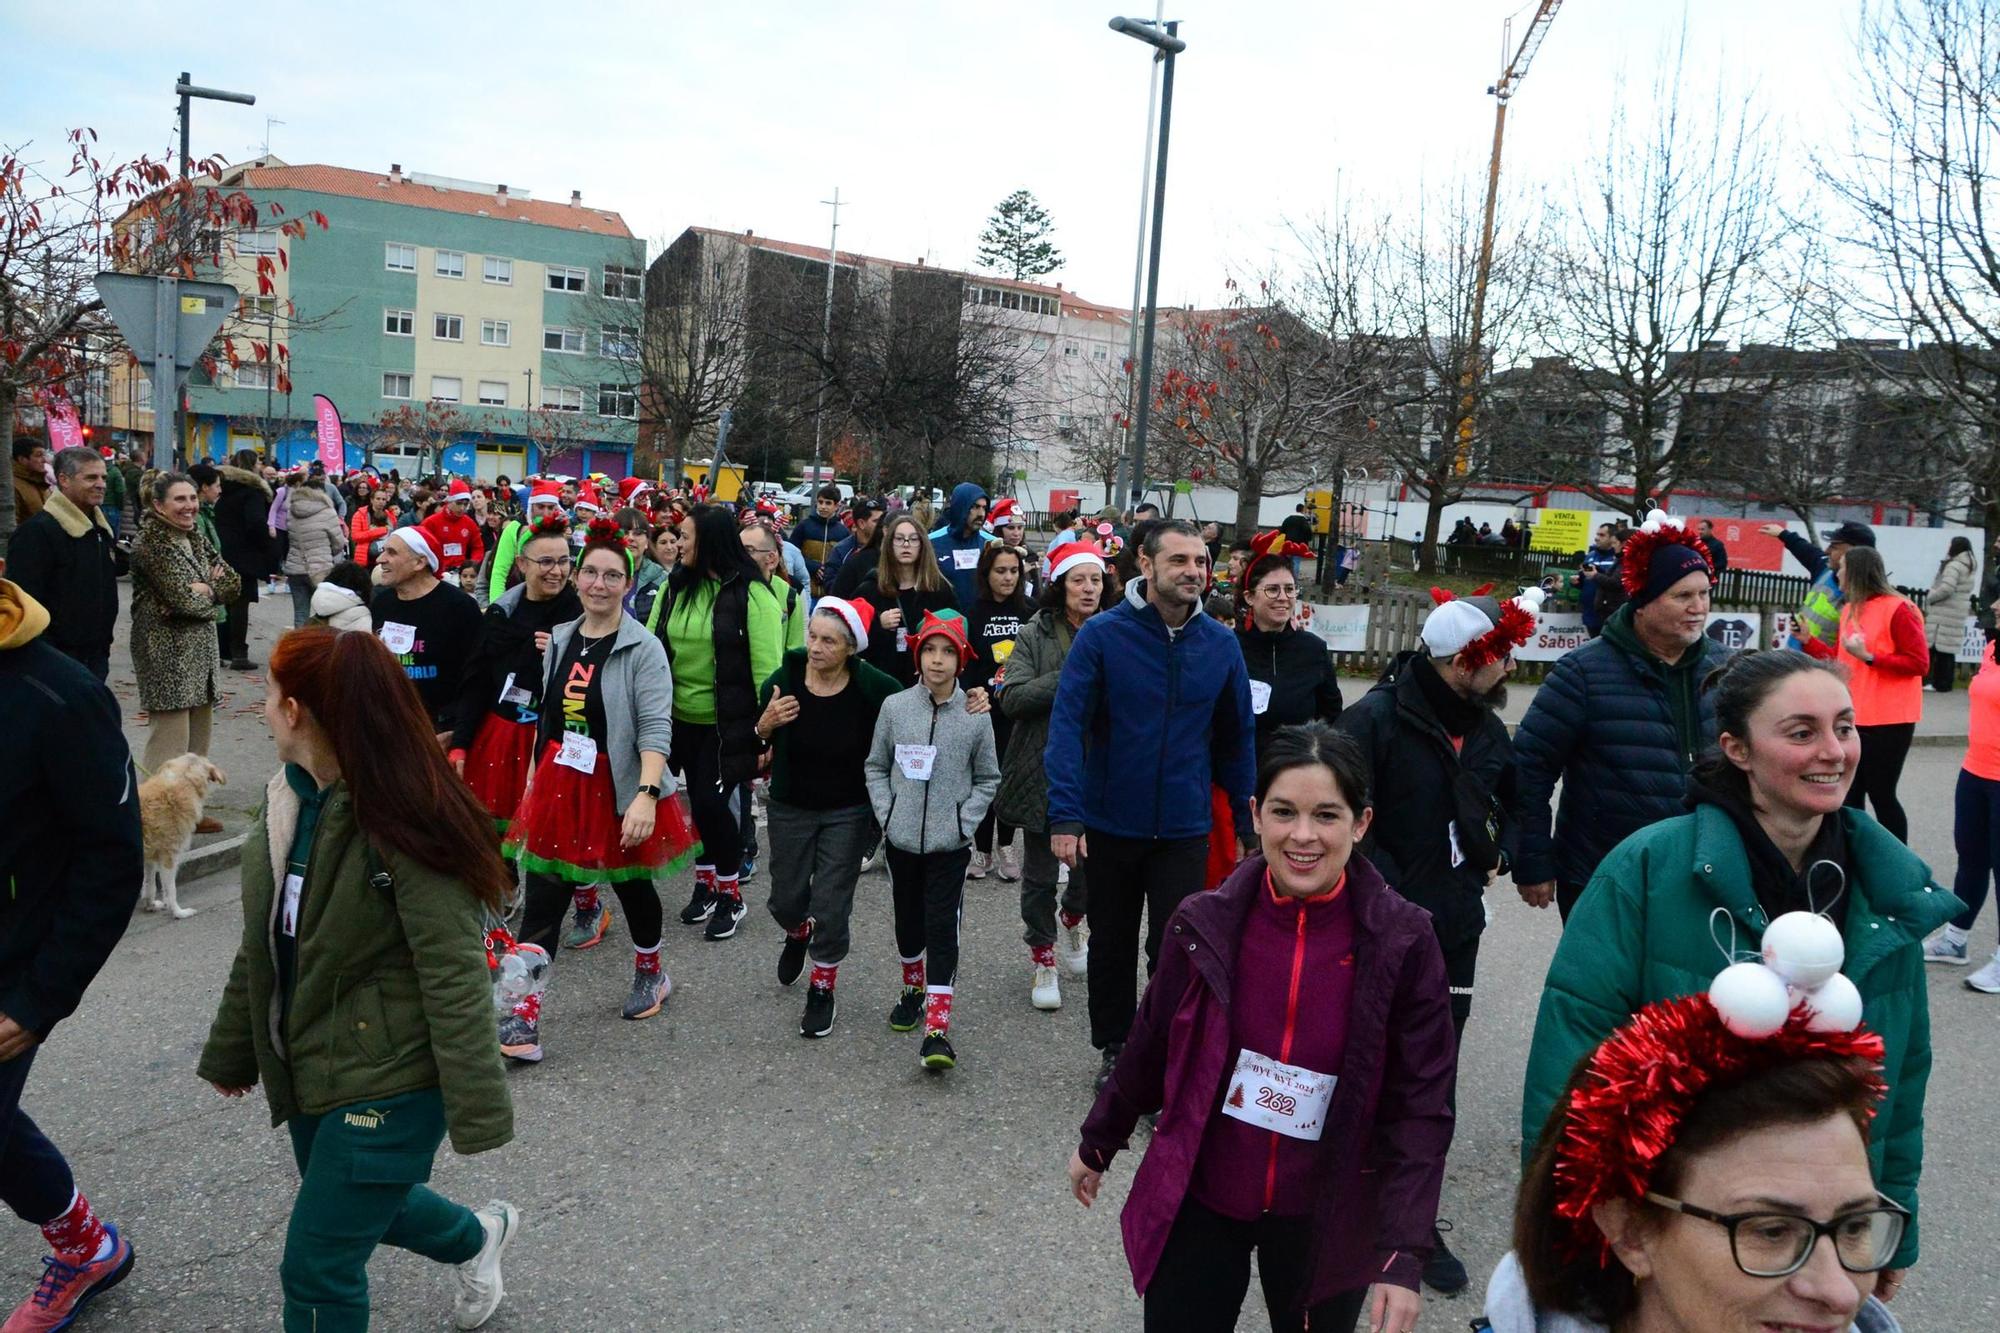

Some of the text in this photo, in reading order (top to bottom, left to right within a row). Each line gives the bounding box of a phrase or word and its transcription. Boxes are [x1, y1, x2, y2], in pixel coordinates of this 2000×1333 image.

[1554, 512, 1576, 520] VENTA
[1548, 625, 1585, 634] Pescados
[404, 665, 437, 679] ORLD
[1295, 1083, 1315, 1094] 2024
[1255, 1086, 1297, 1117] 262
[344, 1112, 378, 1128] PUMA
